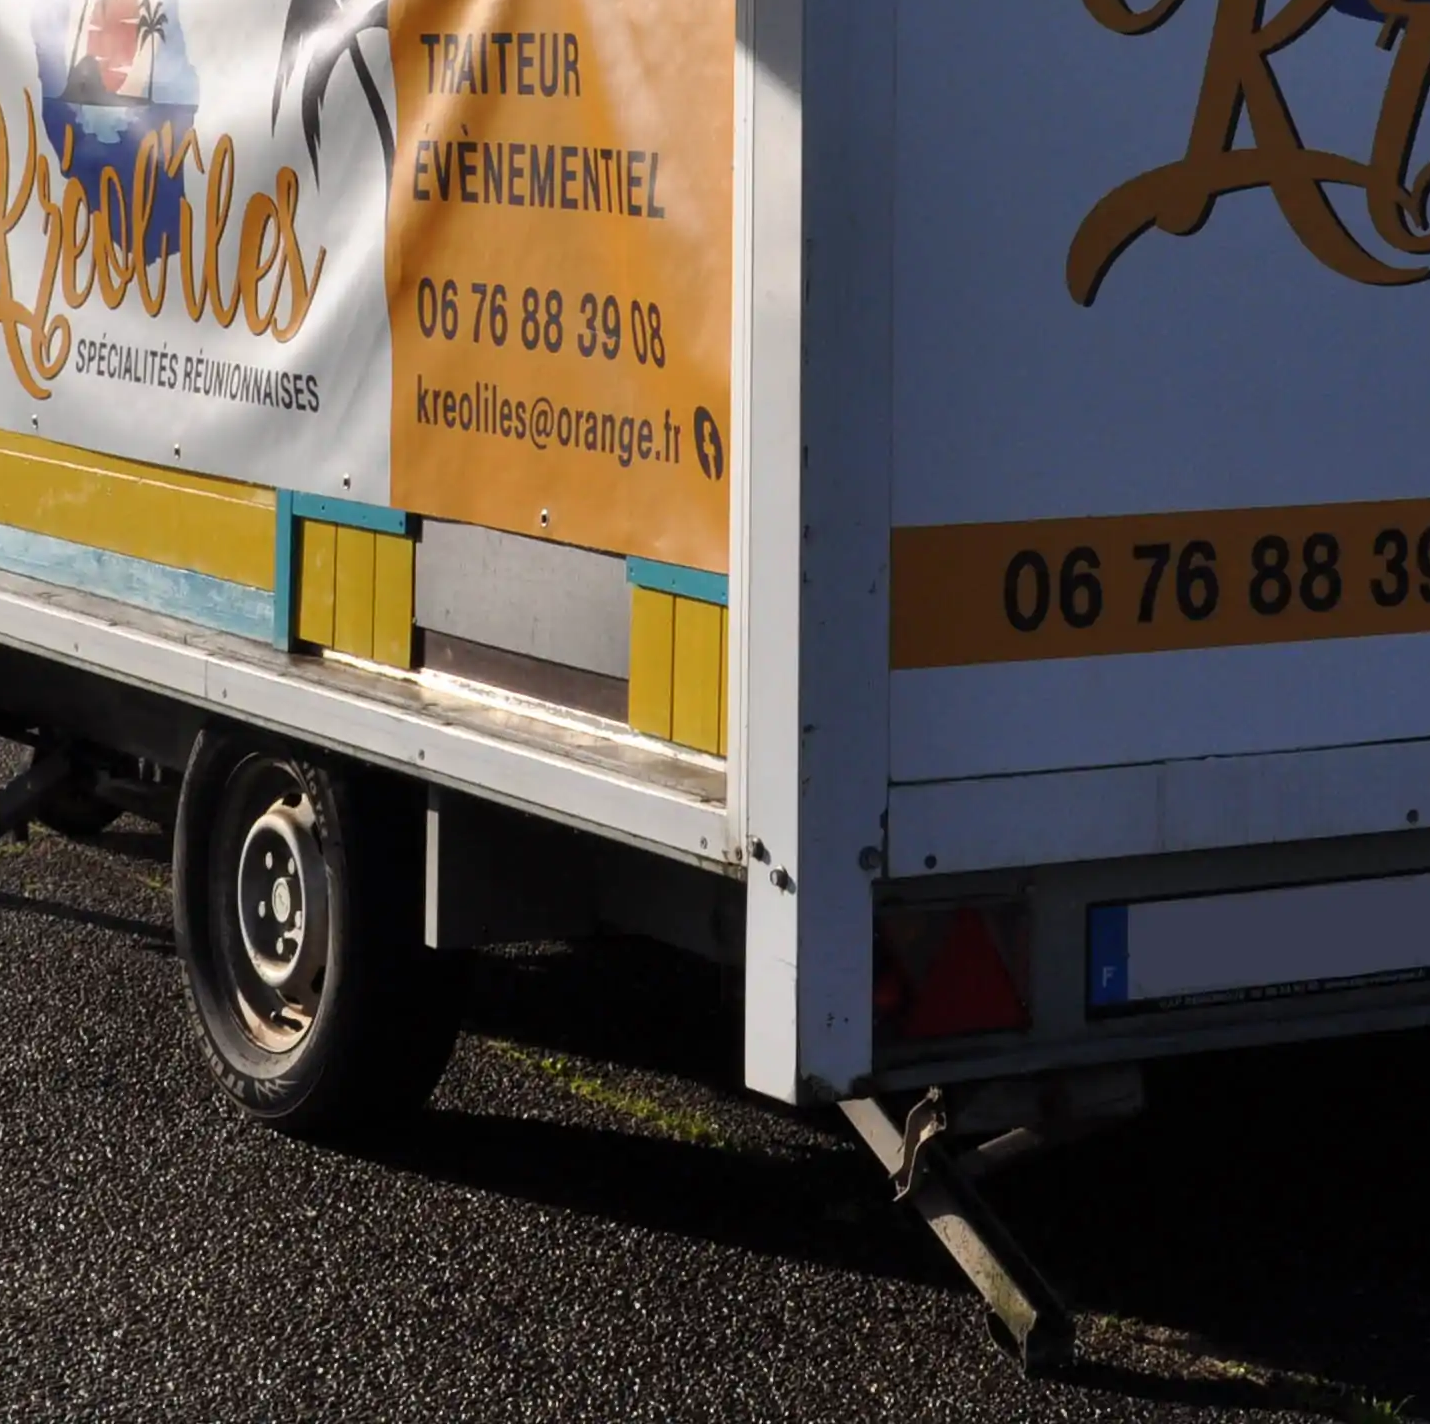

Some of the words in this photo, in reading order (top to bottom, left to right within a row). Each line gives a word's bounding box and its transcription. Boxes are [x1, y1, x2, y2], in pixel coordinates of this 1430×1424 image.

[419, 31, 582, 98] TRAITEUR
[412, 122, 666, 219] ÉVÈNEMENTIEL
[417, 276, 459, 341] 06
[471, 282, 509, 347] 76
[521, 286, 564, 354] 88
[577, 292, 621, 361] 39
[631, 299, 666, 369] 08
[75, 333, 178, 389] SPÉCIALITÉS
[183, 349, 320, 412] RÉUNIONNAISES
[417, 373, 681, 468] kreoliles@orange.fr
[1004, 549, 1103, 632] 06
[1132, 540, 1219, 624] 76
[1248, 532, 1342, 615] 88
[1101, 966, 1117, 989] F
